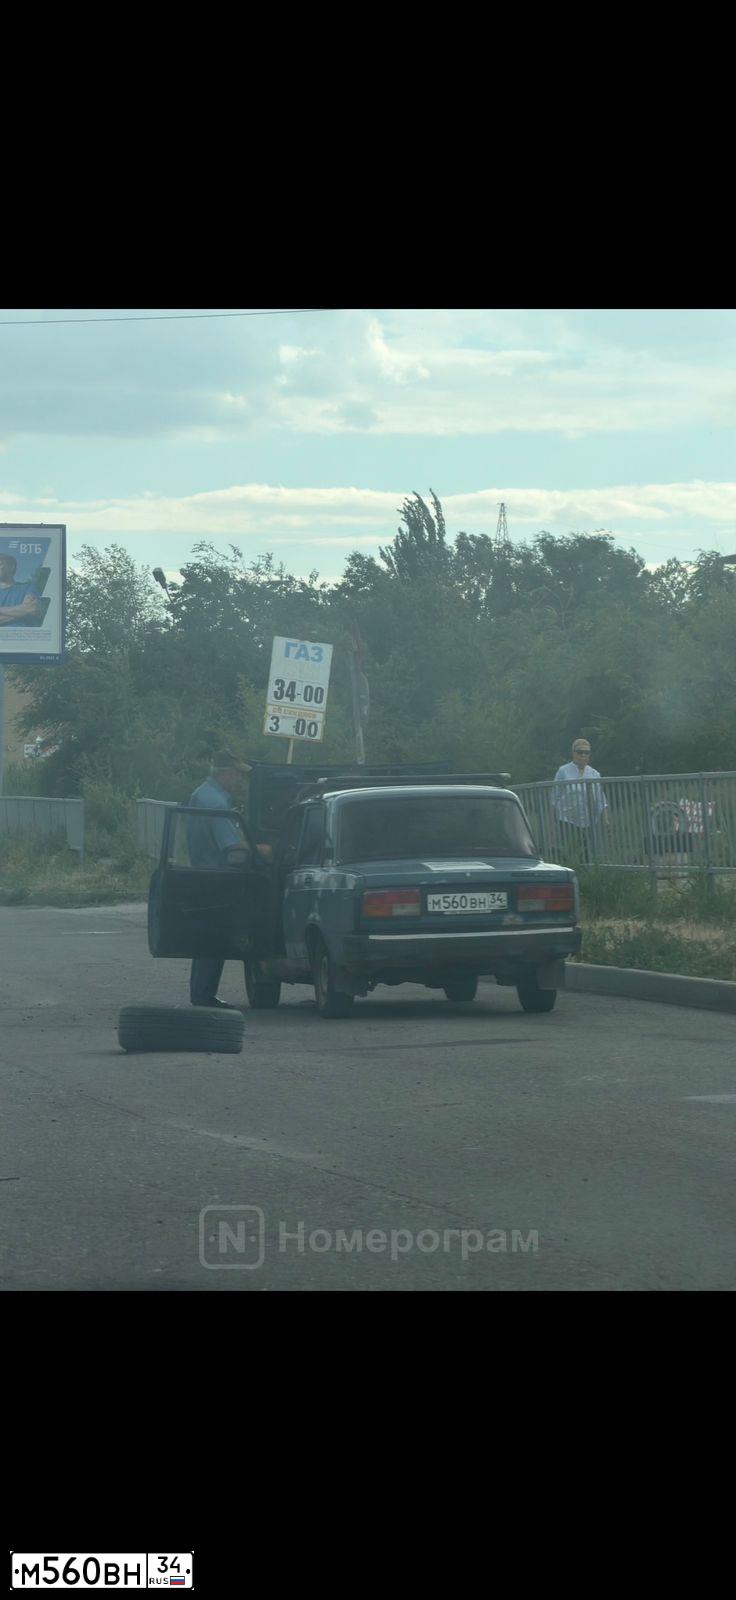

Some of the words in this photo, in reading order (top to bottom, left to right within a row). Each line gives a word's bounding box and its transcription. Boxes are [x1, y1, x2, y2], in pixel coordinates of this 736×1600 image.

[19, 543, 42, 554] ВТБ
[284, 642, 324, 663] ГАЗ
[273, 678, 325, 704] 34-00
[432, 895, 487, 910] М560ВН
[489, 893, 503, 904] 34
